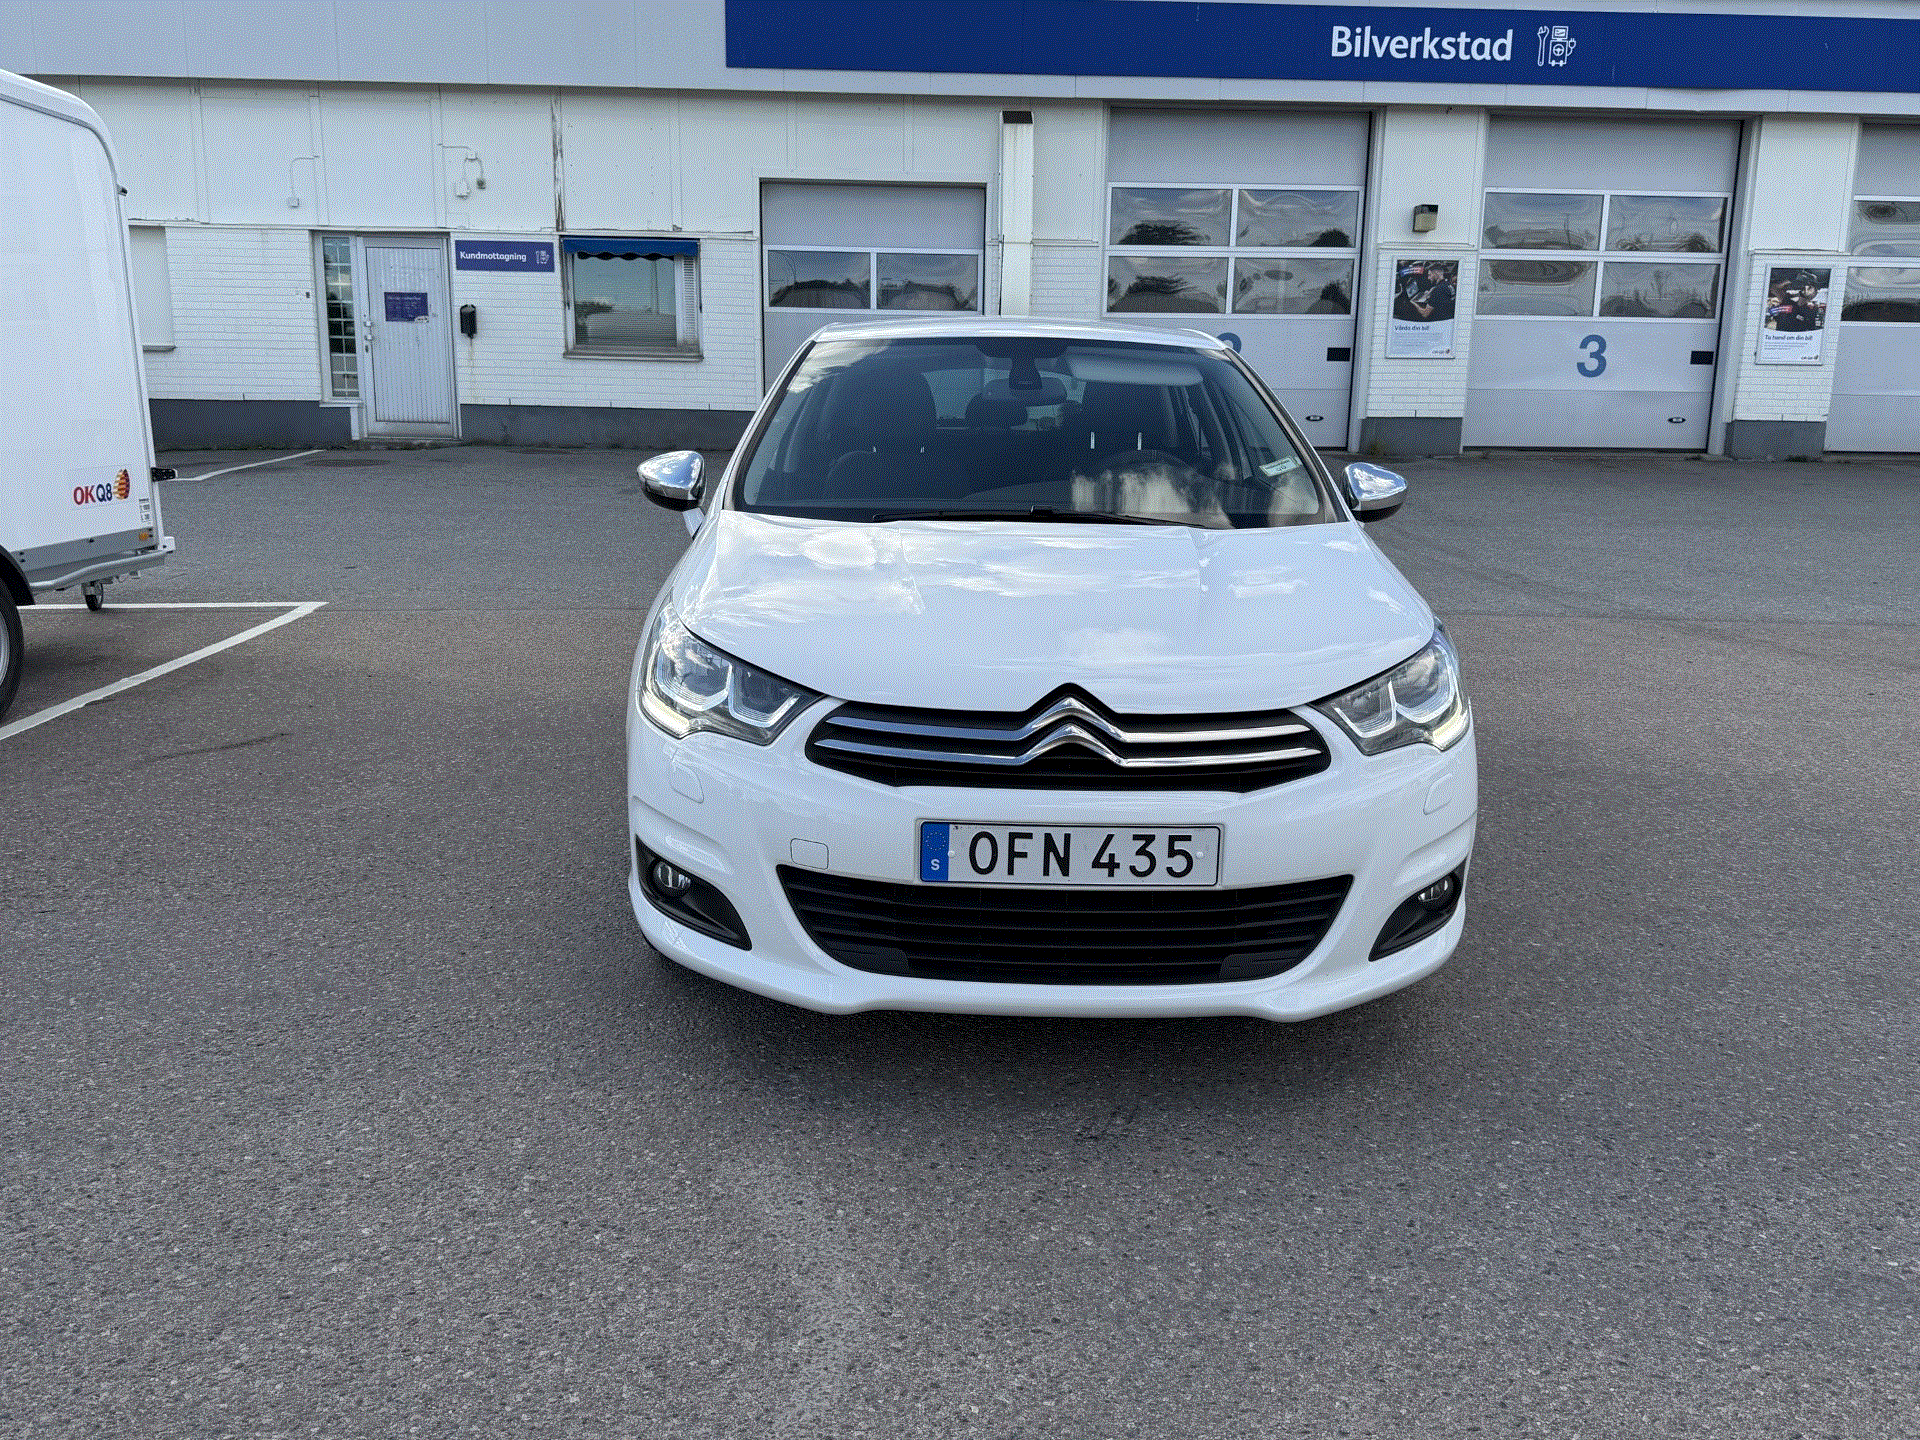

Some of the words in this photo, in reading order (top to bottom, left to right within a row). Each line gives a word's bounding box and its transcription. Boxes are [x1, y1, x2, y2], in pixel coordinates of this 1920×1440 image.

[1331, 25, 1514, 61] Bilverkstad
[460, 250, 527, 262] Kundmottagning
[1576, 334, 1607, 378] 3
[930, 858, 941, 871] S
[968, 831, 1071, 877] OFN
[1091, 833, 1194, 878] 435
